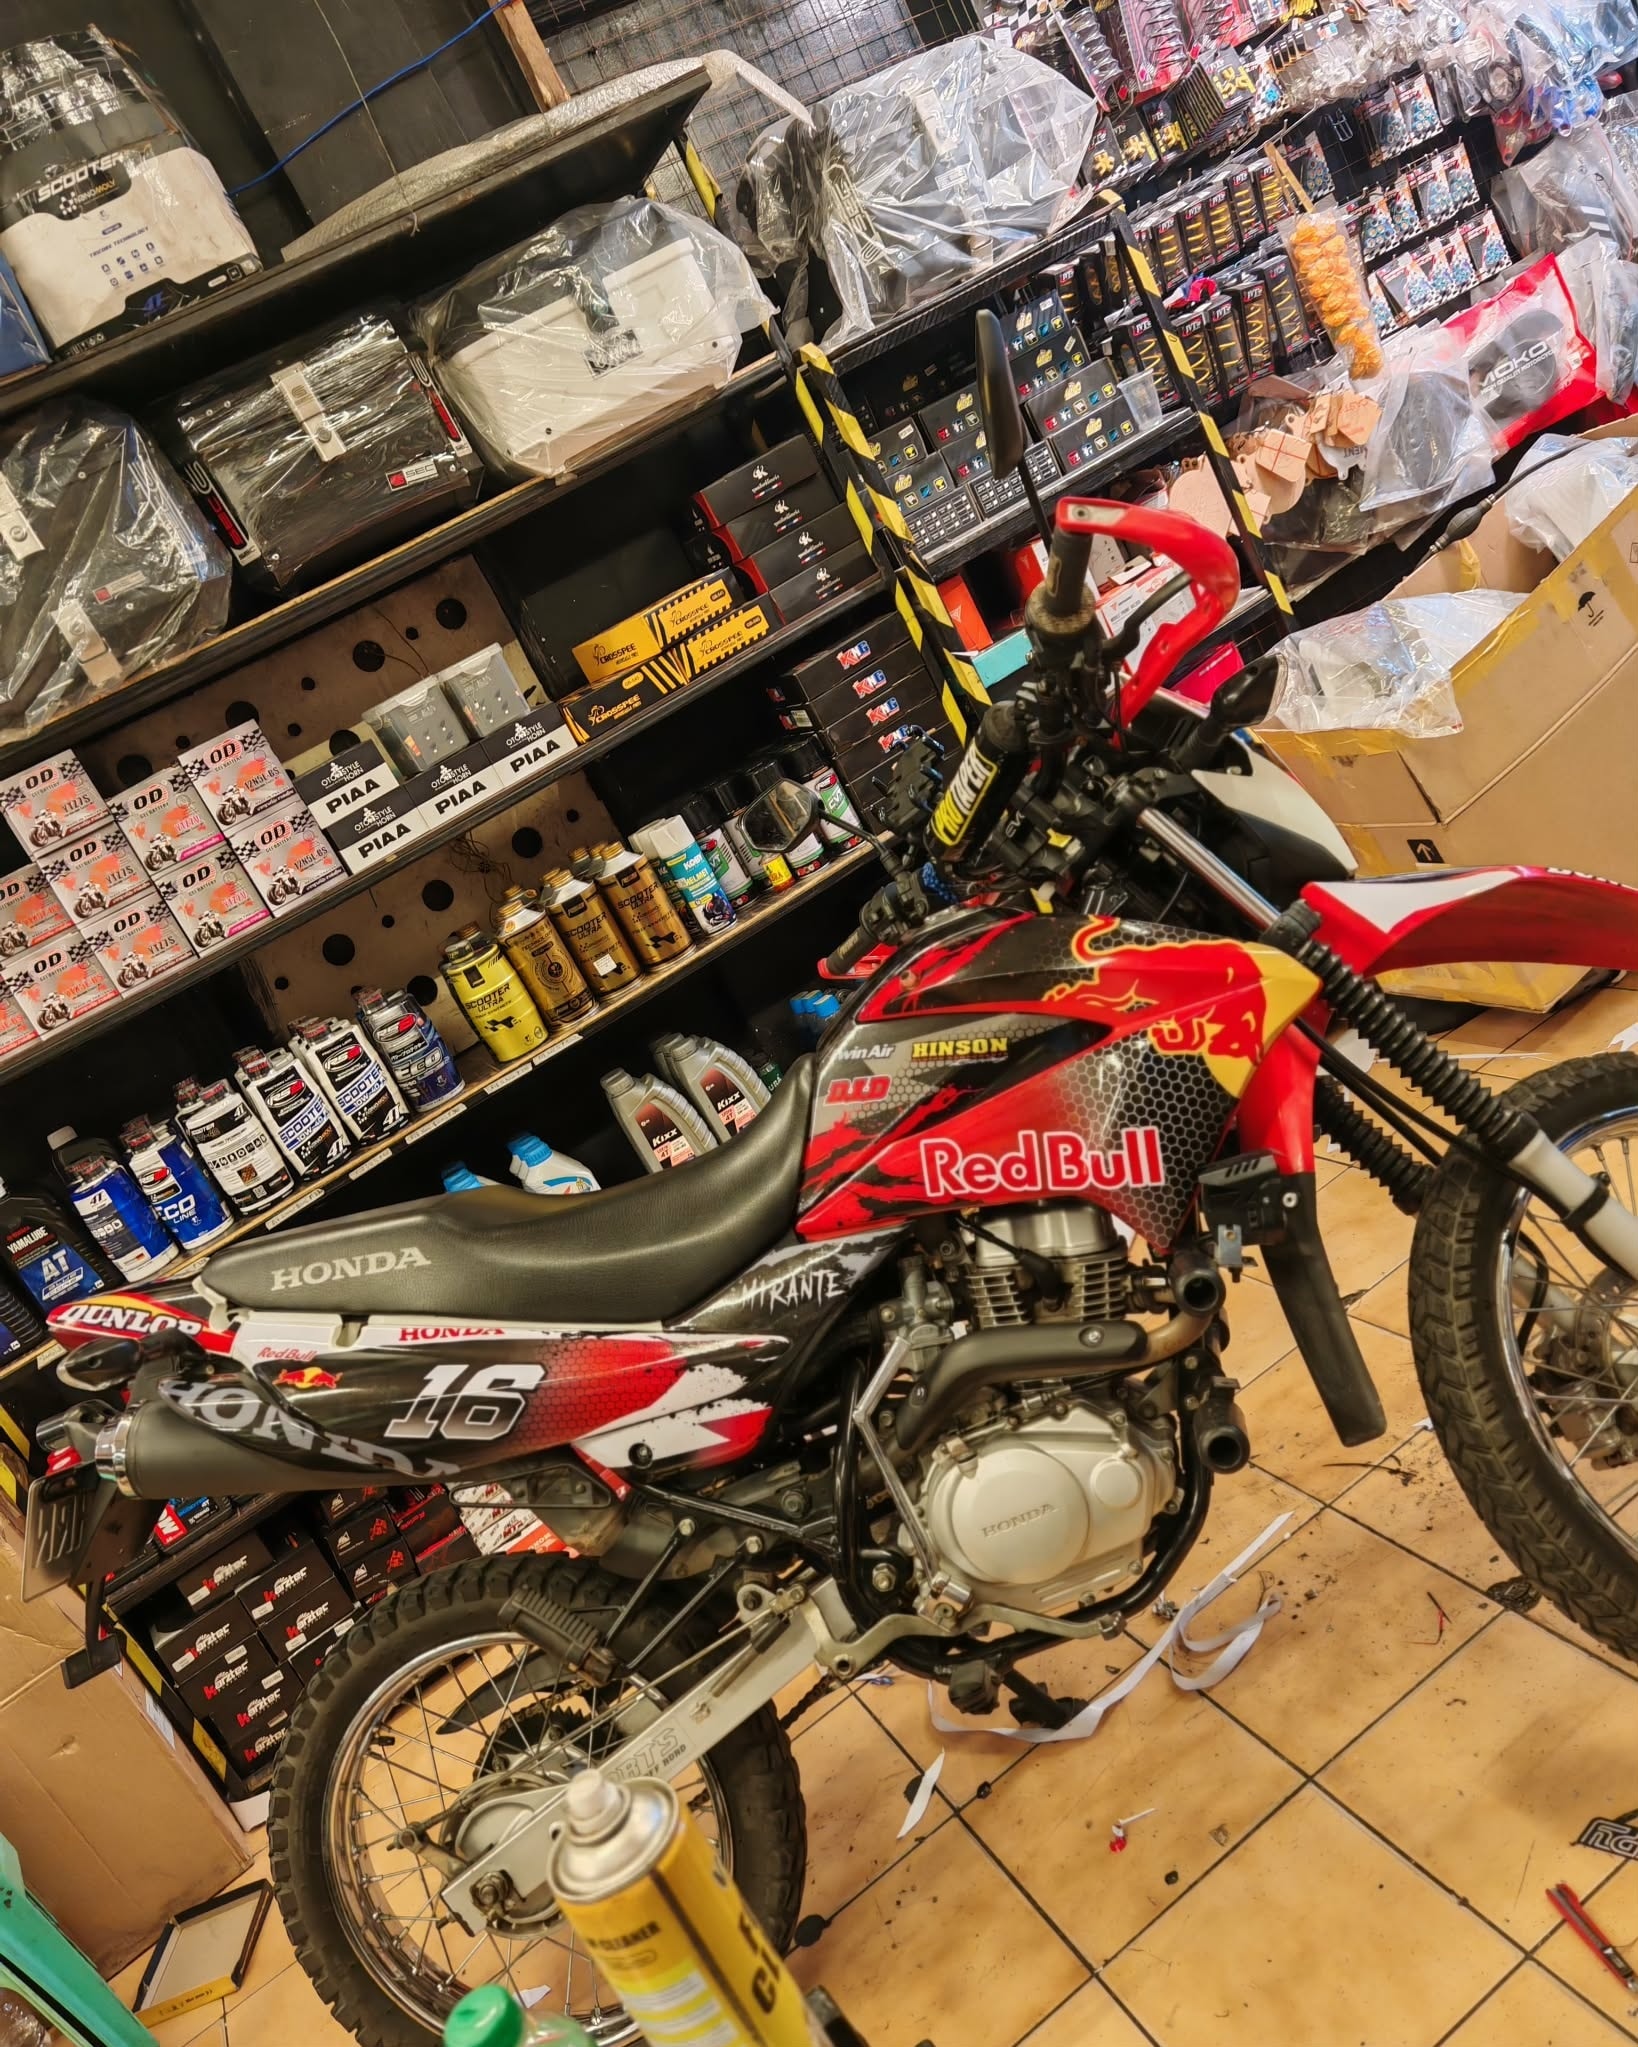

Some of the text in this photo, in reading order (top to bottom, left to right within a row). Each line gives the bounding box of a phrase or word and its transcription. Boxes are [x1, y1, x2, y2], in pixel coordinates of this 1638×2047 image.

[38, 151, 124, 203] SCOOTER
[405, 462, 435, 479] SEC
[210, 743, 236, 764] OD
[509, 739, 560, 773] PIAA
[25, 768, 54, 790] OD
[133, 788, 163, 810] OD
[326, 778, 380, 814] PIAA
[434, 780, 487, 815] PIAA
[260, 823, 287, 846] OD
[358, 823, 411, 859] PIAA
[69, 841, 97, 863] OD
[182, 866, 211, 888] OD
[617, 881, 659, 909] SCOOTER
[113, 912, 141, 933] OD
[33, 952, 62, 974] OD
[464, 983, 511, 1010] SCOOTER
[477, 996, 504, 1013] ULTRA
[912, 1037, 1008, 1060] HINSON
[340, 1064, 383, 1108] SCOOTER
[280, 1099, 325, 1143] SCOOTER
[173, 1208, 197, 1224] LINE
[7, 1226, 49, 1254] YAMALUBE
[42, 1248, 70, 1283] AT
[271, 1247, 431, 1291] HONDA
[740, 1269, 845, 1315] MIRANTE
[400, 1327, 506, 1343] HONDA
[384, 1364, 547, 1441] 16
[981, 1503, 1059, 1539] HONDA
